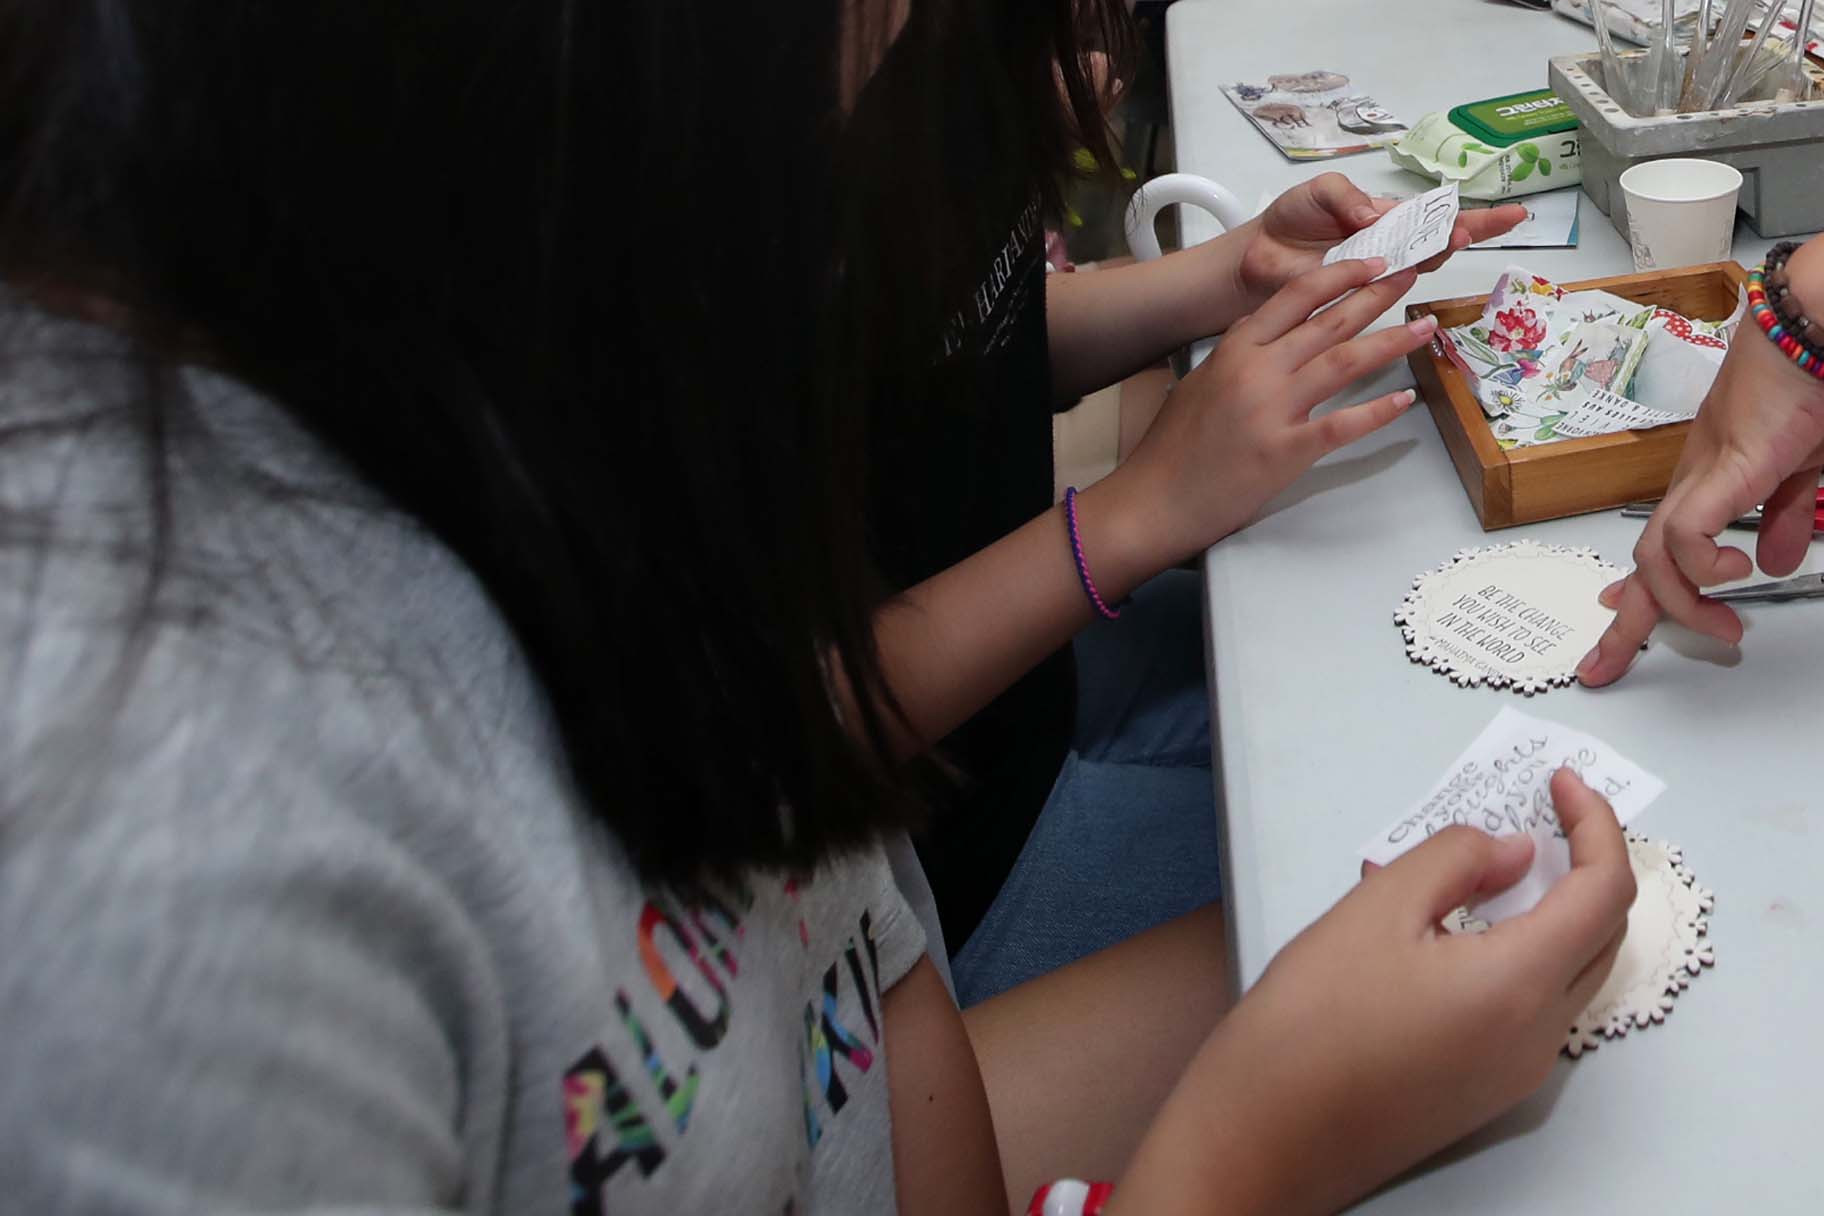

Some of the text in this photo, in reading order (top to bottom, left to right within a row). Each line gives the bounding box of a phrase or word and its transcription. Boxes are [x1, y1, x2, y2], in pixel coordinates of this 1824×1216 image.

[1591, 389, 1629, 408] DANKE
[1436, 612, 1526, 664] IN THE WORLD
[1452, 594, 1557, 656] YOU WISH TO SEE
[1478, 585, 1576, 641] BE THE CHANGE
